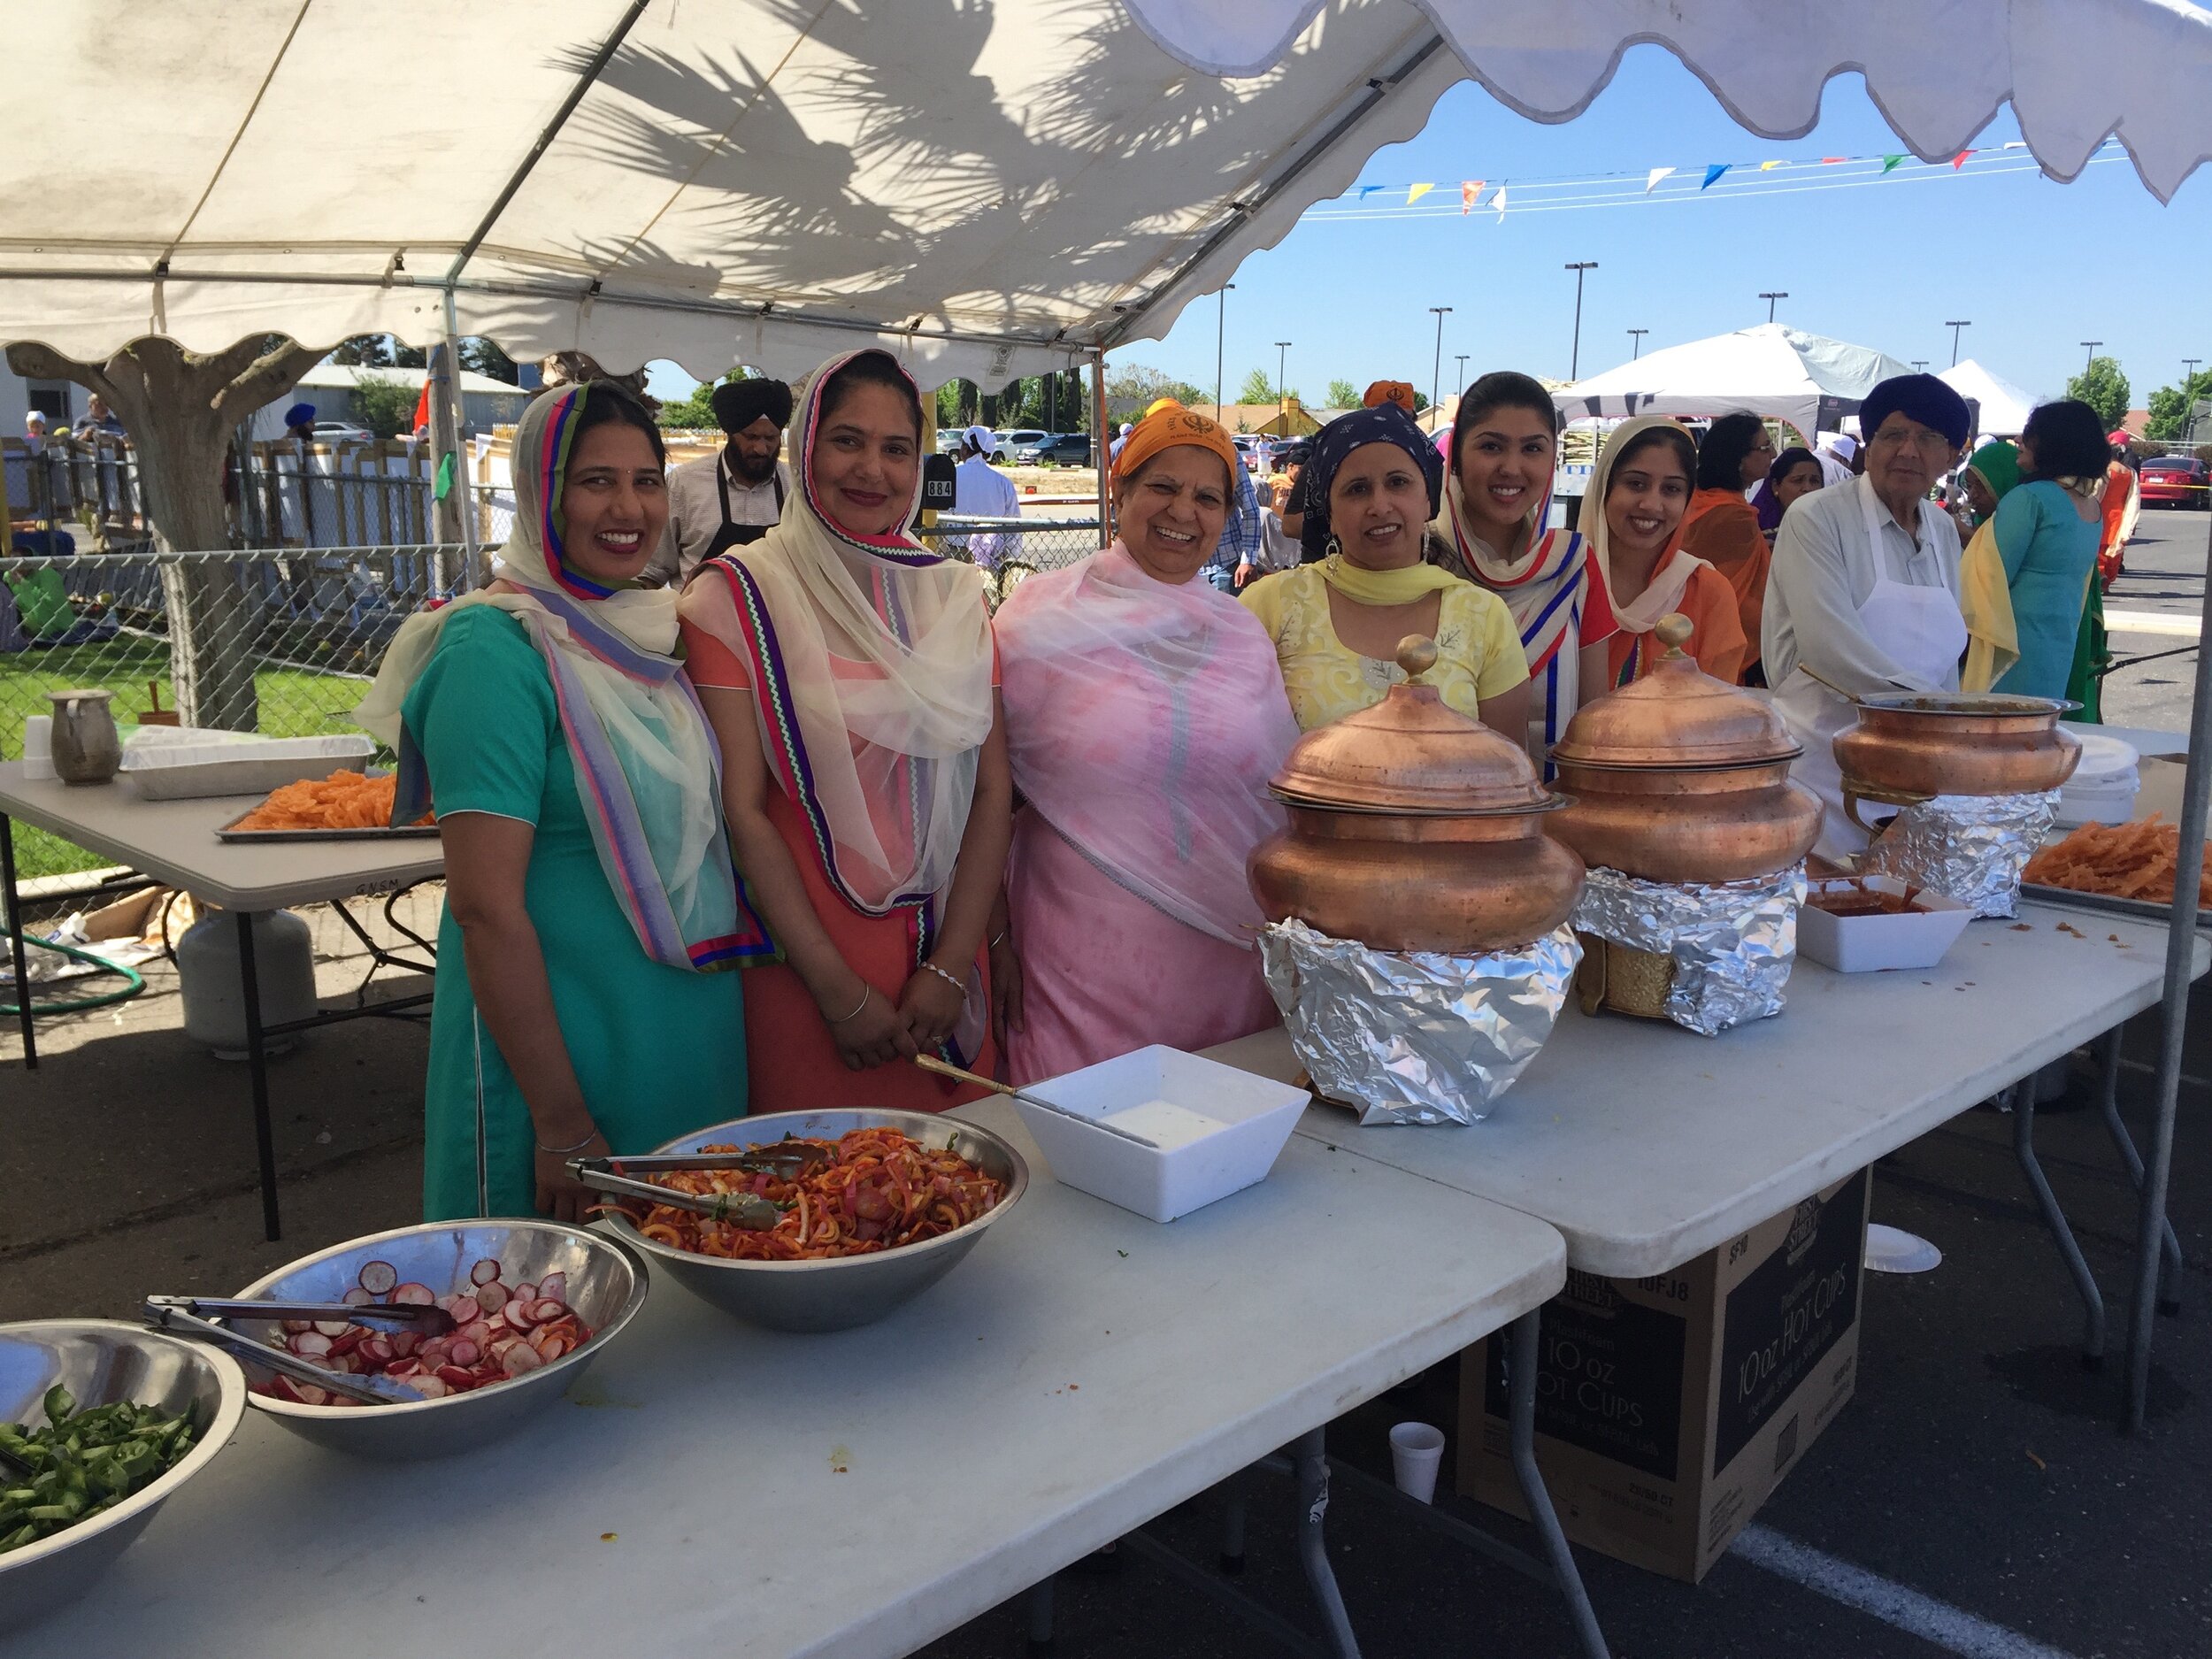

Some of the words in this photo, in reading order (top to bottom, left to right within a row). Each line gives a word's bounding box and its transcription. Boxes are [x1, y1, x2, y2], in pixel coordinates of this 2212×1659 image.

[929, 482, 951, 495] 884
[1548, 1337, 1580, 1371] 10
[1536, 1371, 1570, 1400] OT
[1739, 1350, 1759, 1403] 10
